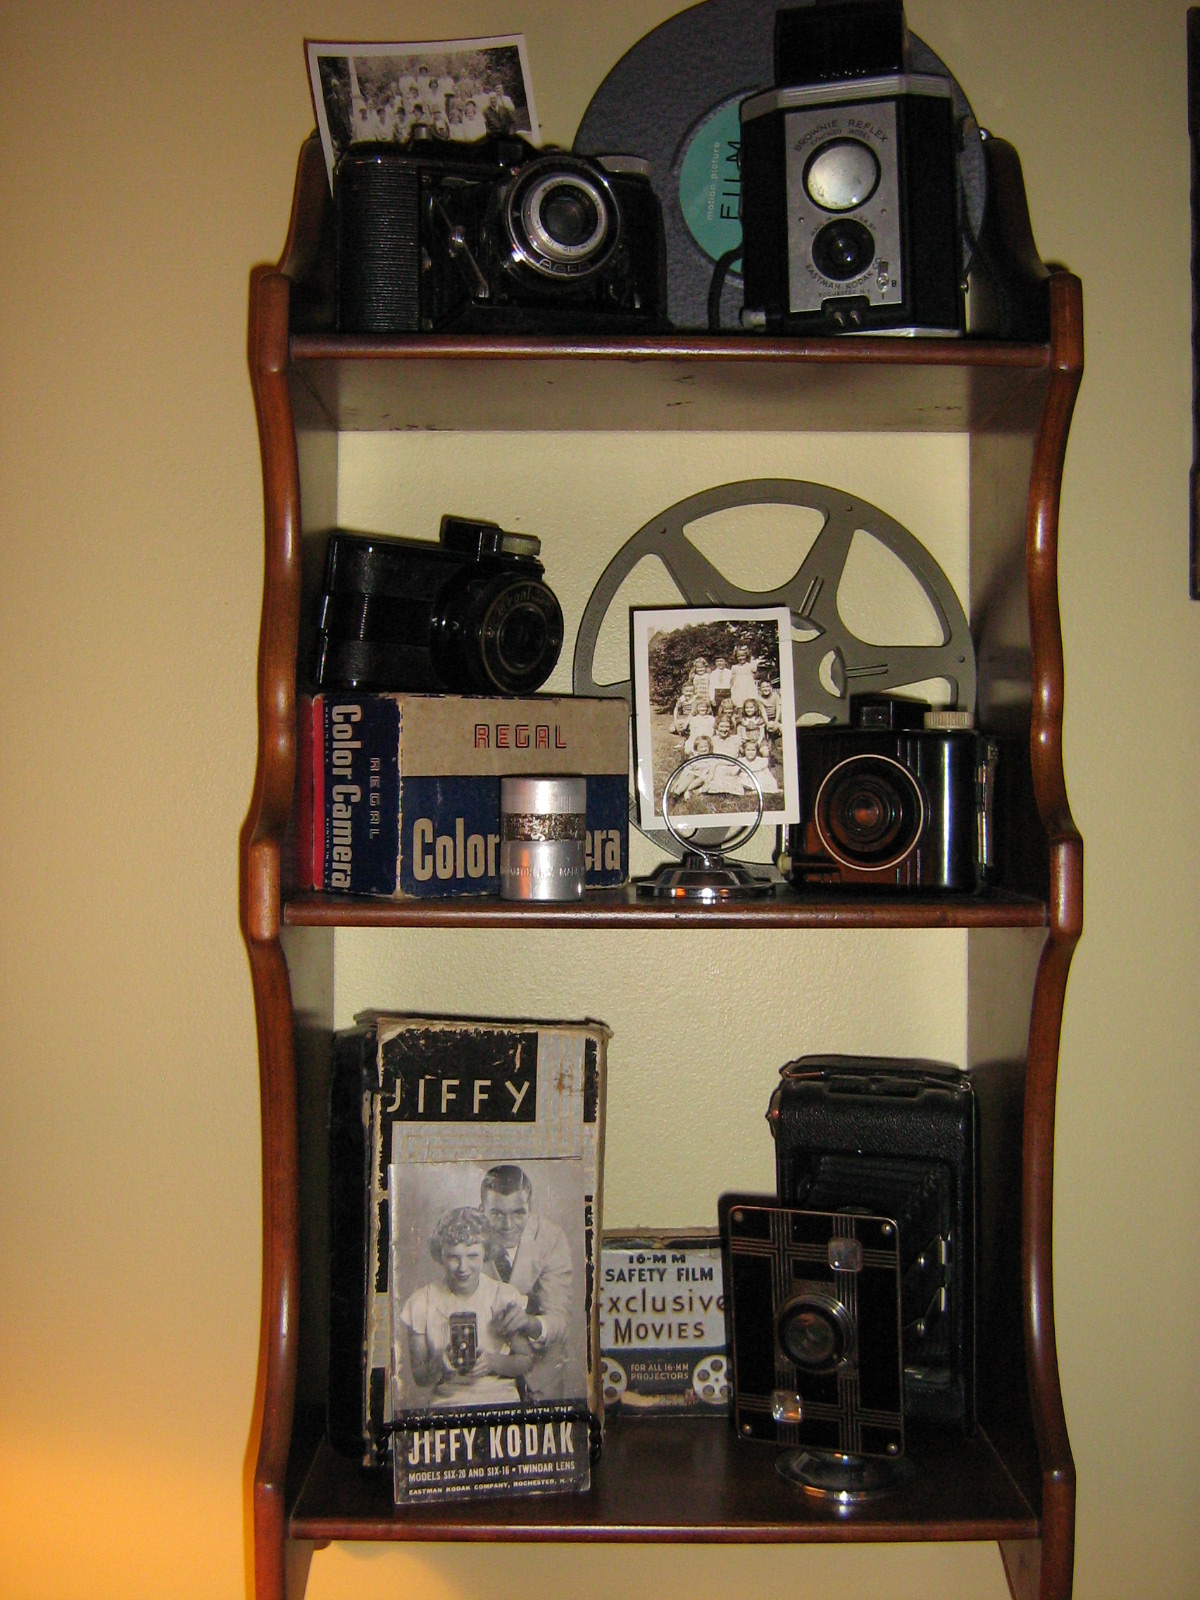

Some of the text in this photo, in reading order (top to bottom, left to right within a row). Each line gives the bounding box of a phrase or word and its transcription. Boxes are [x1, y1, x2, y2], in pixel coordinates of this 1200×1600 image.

[794, 119, 888, 152] BROWNIE REFLEX
[707, 142, 720, 221] motion picture
[805, 264, 841, 290] EASTMAN
[845, 270, 874, 290] KODAK
[474, 724, 567, 749] REGAL
[332, 704, 362, 888] Color Camera
[369, 757, 380, 840] REGAL
[412, 817, 500, 882] Color
[387, 1078, 530, 1115] JIFFY
[605, 1267, 713, 1282] SAFETY FILM
[600, 1287, 725, 1314] xclusive
[614, 1318, 705, 1344] MOVIES
[630, 1363, 646, 1371] FOR
[648, 1363, 662, 1371] ALL
[630, 1372, 689, 1380] PROJECTORS
[526, 1406, 550, 1414] WITH
[408, 1421, 575, 1465] JIFFY KODAK
[408, 1461, 575, 1483] MODELS SIX-20 AND SIX-16 TWINDAR LENS
[408, 1488, 443, 1496] EASTMAN
[474, 1482, 511, 1490] COMPANY,
[513, 1479, 557, 1487] ROCHESTER,
